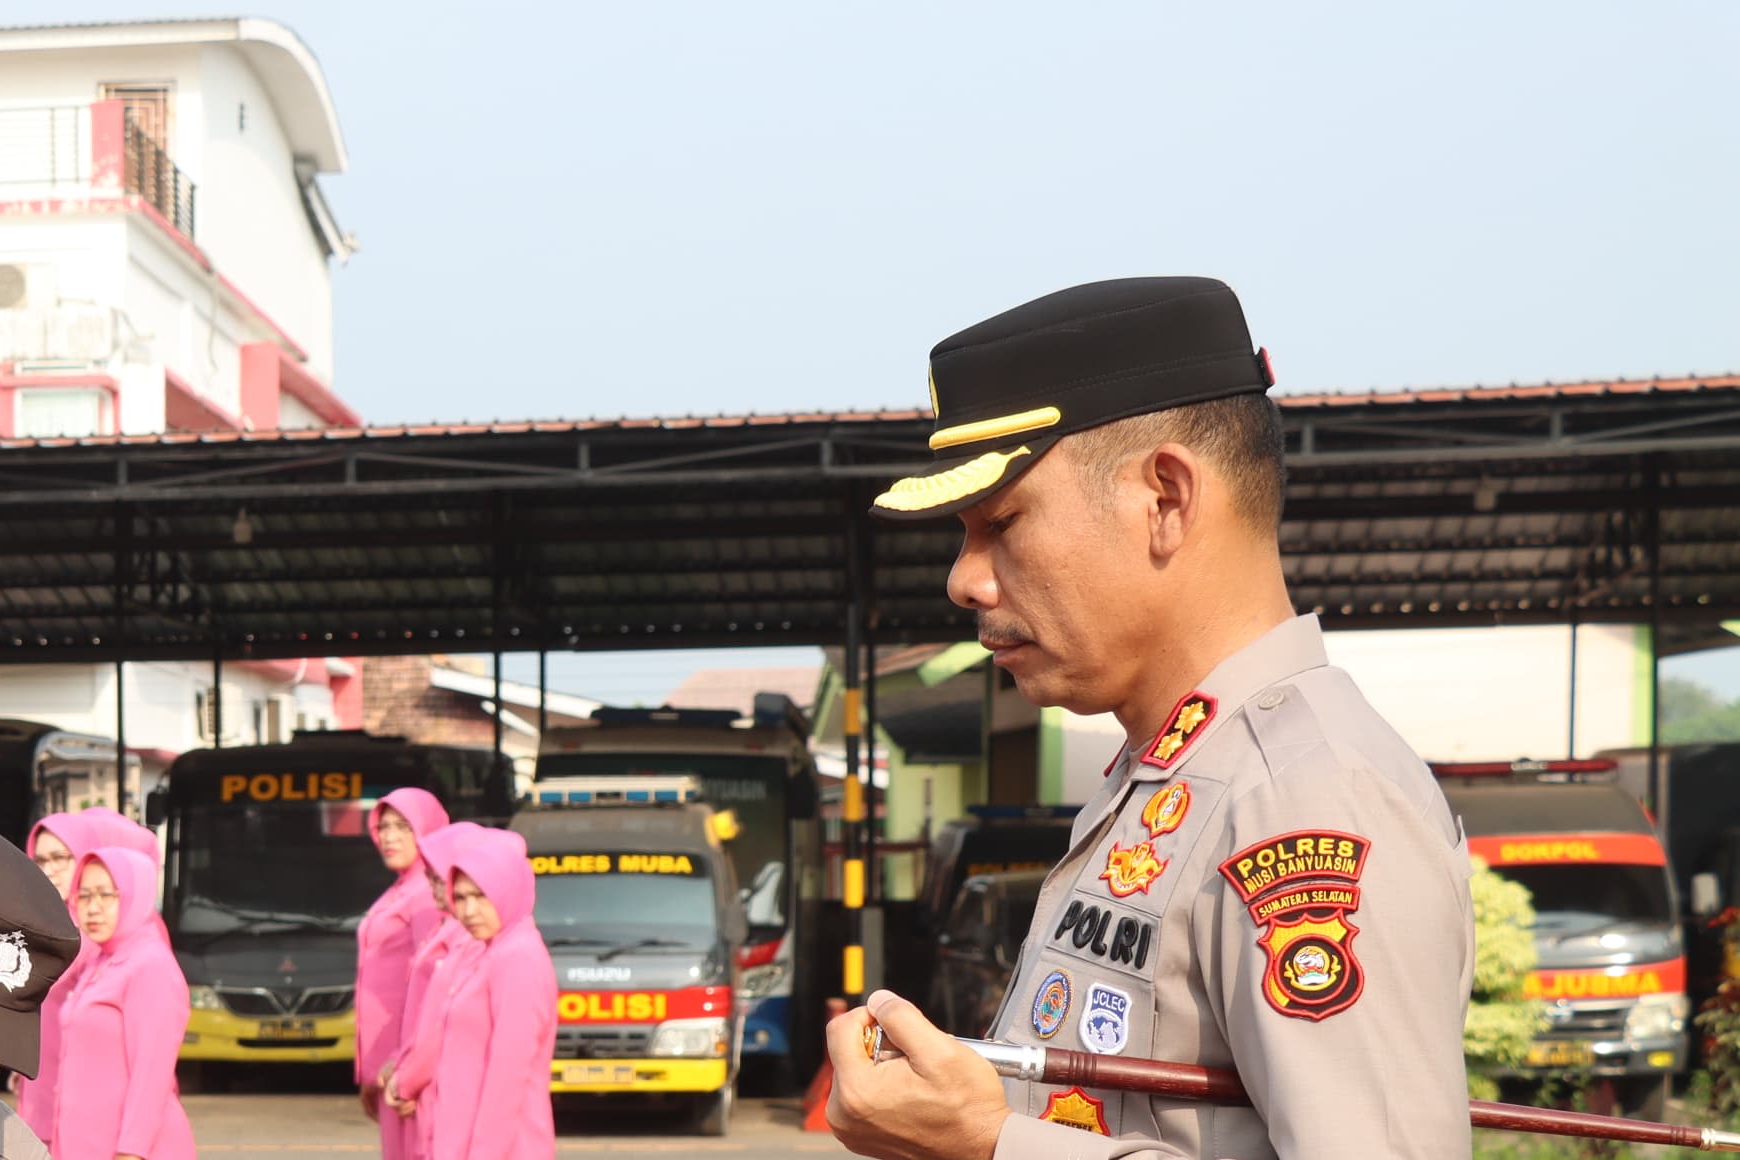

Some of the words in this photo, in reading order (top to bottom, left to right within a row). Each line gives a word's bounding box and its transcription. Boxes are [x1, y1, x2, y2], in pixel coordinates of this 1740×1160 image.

[221, 773, 363, 801] POLISI
[530, 855, 611, 874] OLRES
[618, 855, 693, 874] MUBA
[1236, 837, 1355, 878] POLRES
[1243, 867, 1276, 894] MUSI
[1277, 855, 1357, 877] BANYUASIN
[1259, 892, 1310, 917] SUMATERA
[1311, 890, 1353, 904] SELATAN
[1054, 899, 1152, 970] POLRI
[567, 967, 631, 982] ISUZU
[558, 992, 668, 1020] OLISI
[1093, 989, 1126, 1013] JCLEC
